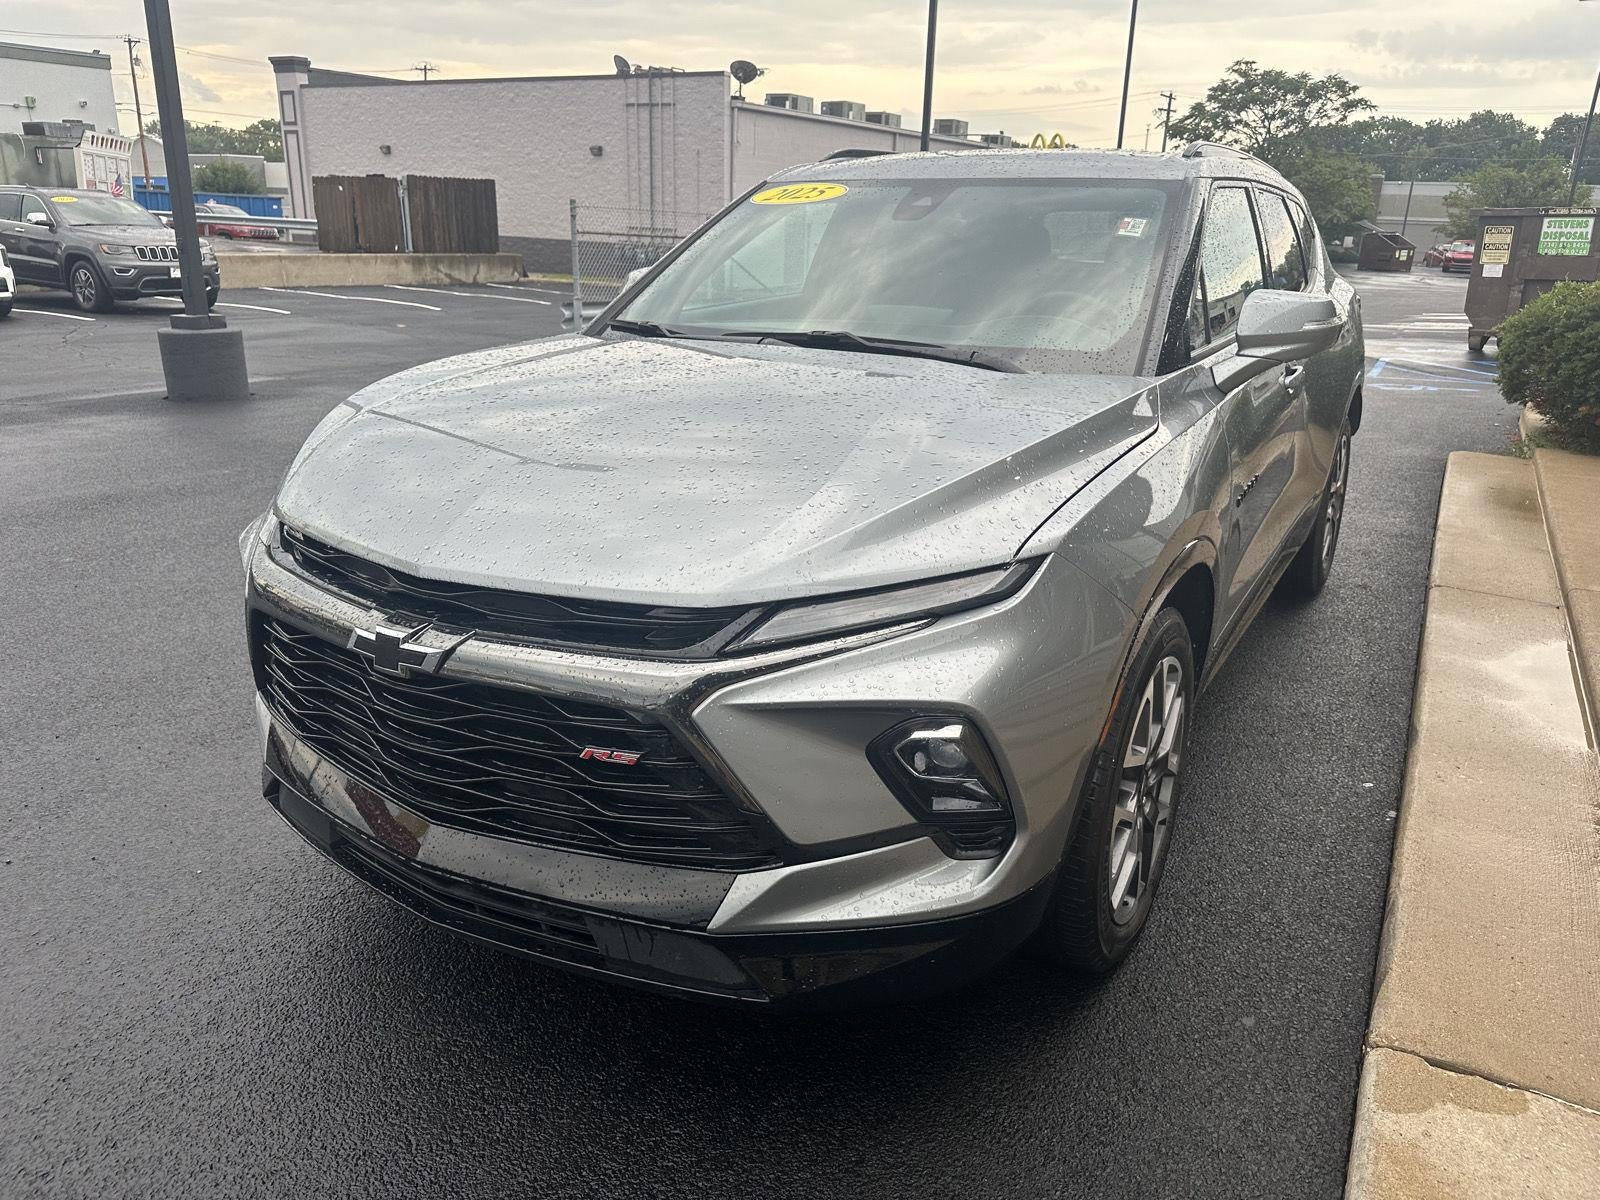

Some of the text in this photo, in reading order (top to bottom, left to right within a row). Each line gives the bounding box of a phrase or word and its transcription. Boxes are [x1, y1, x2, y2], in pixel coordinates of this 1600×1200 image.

[761, 187, 836, 201] 2025
[1546, 219, 1590, 229] STEVENS
[1542, 230, 1590, 241] DISPOSAL
[579, 747, 641, 766] RS
